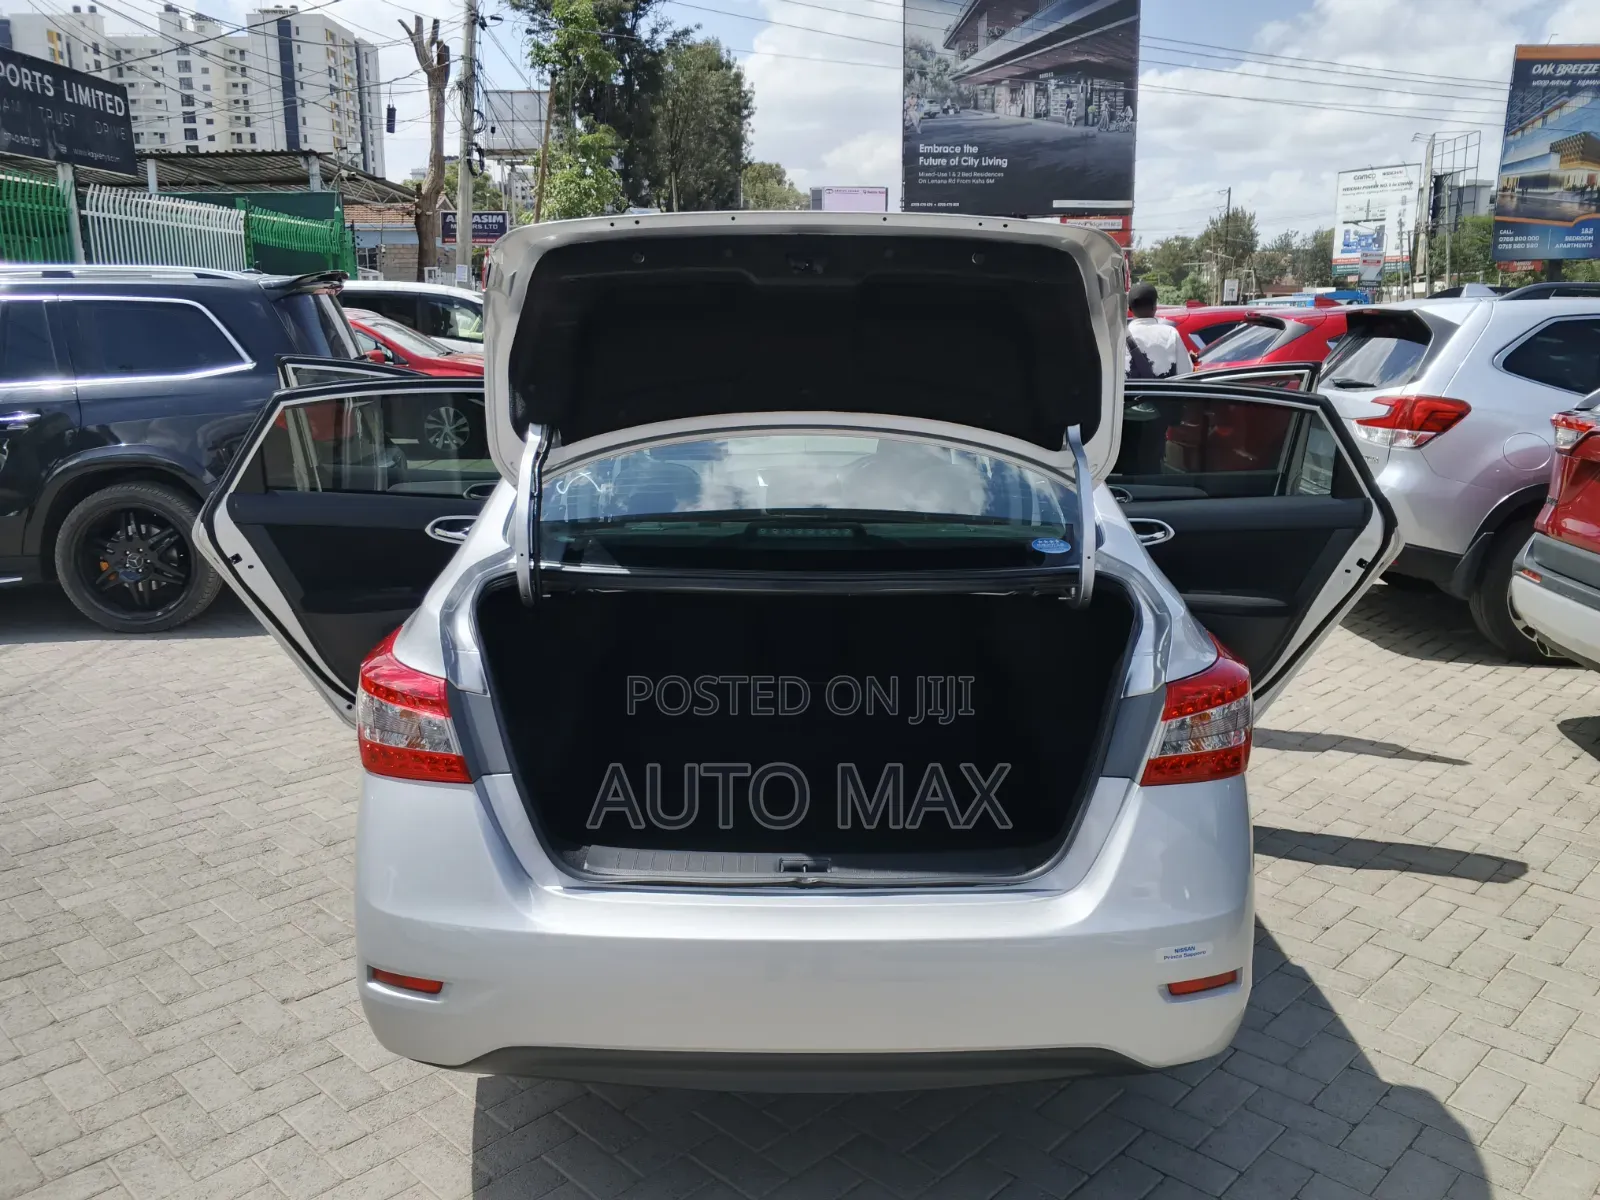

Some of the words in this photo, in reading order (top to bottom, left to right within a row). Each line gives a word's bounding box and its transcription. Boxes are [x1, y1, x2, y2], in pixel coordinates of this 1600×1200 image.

[1532, 63, 1555, 75] OAK
[1555, 63, 1600, 76] BREEZE
[63, 80, 125, 116] LIMITED
[38, 106, 75, 127] TRUST
[919, 144, 961, 153] Embrace
[963, 144, 979, 153] the
[919, 157, 947, 166] Future
[949, 157, 959, 166] of
[961, 157, 979, 167] City
[982, 157, 1008, 168] Living
